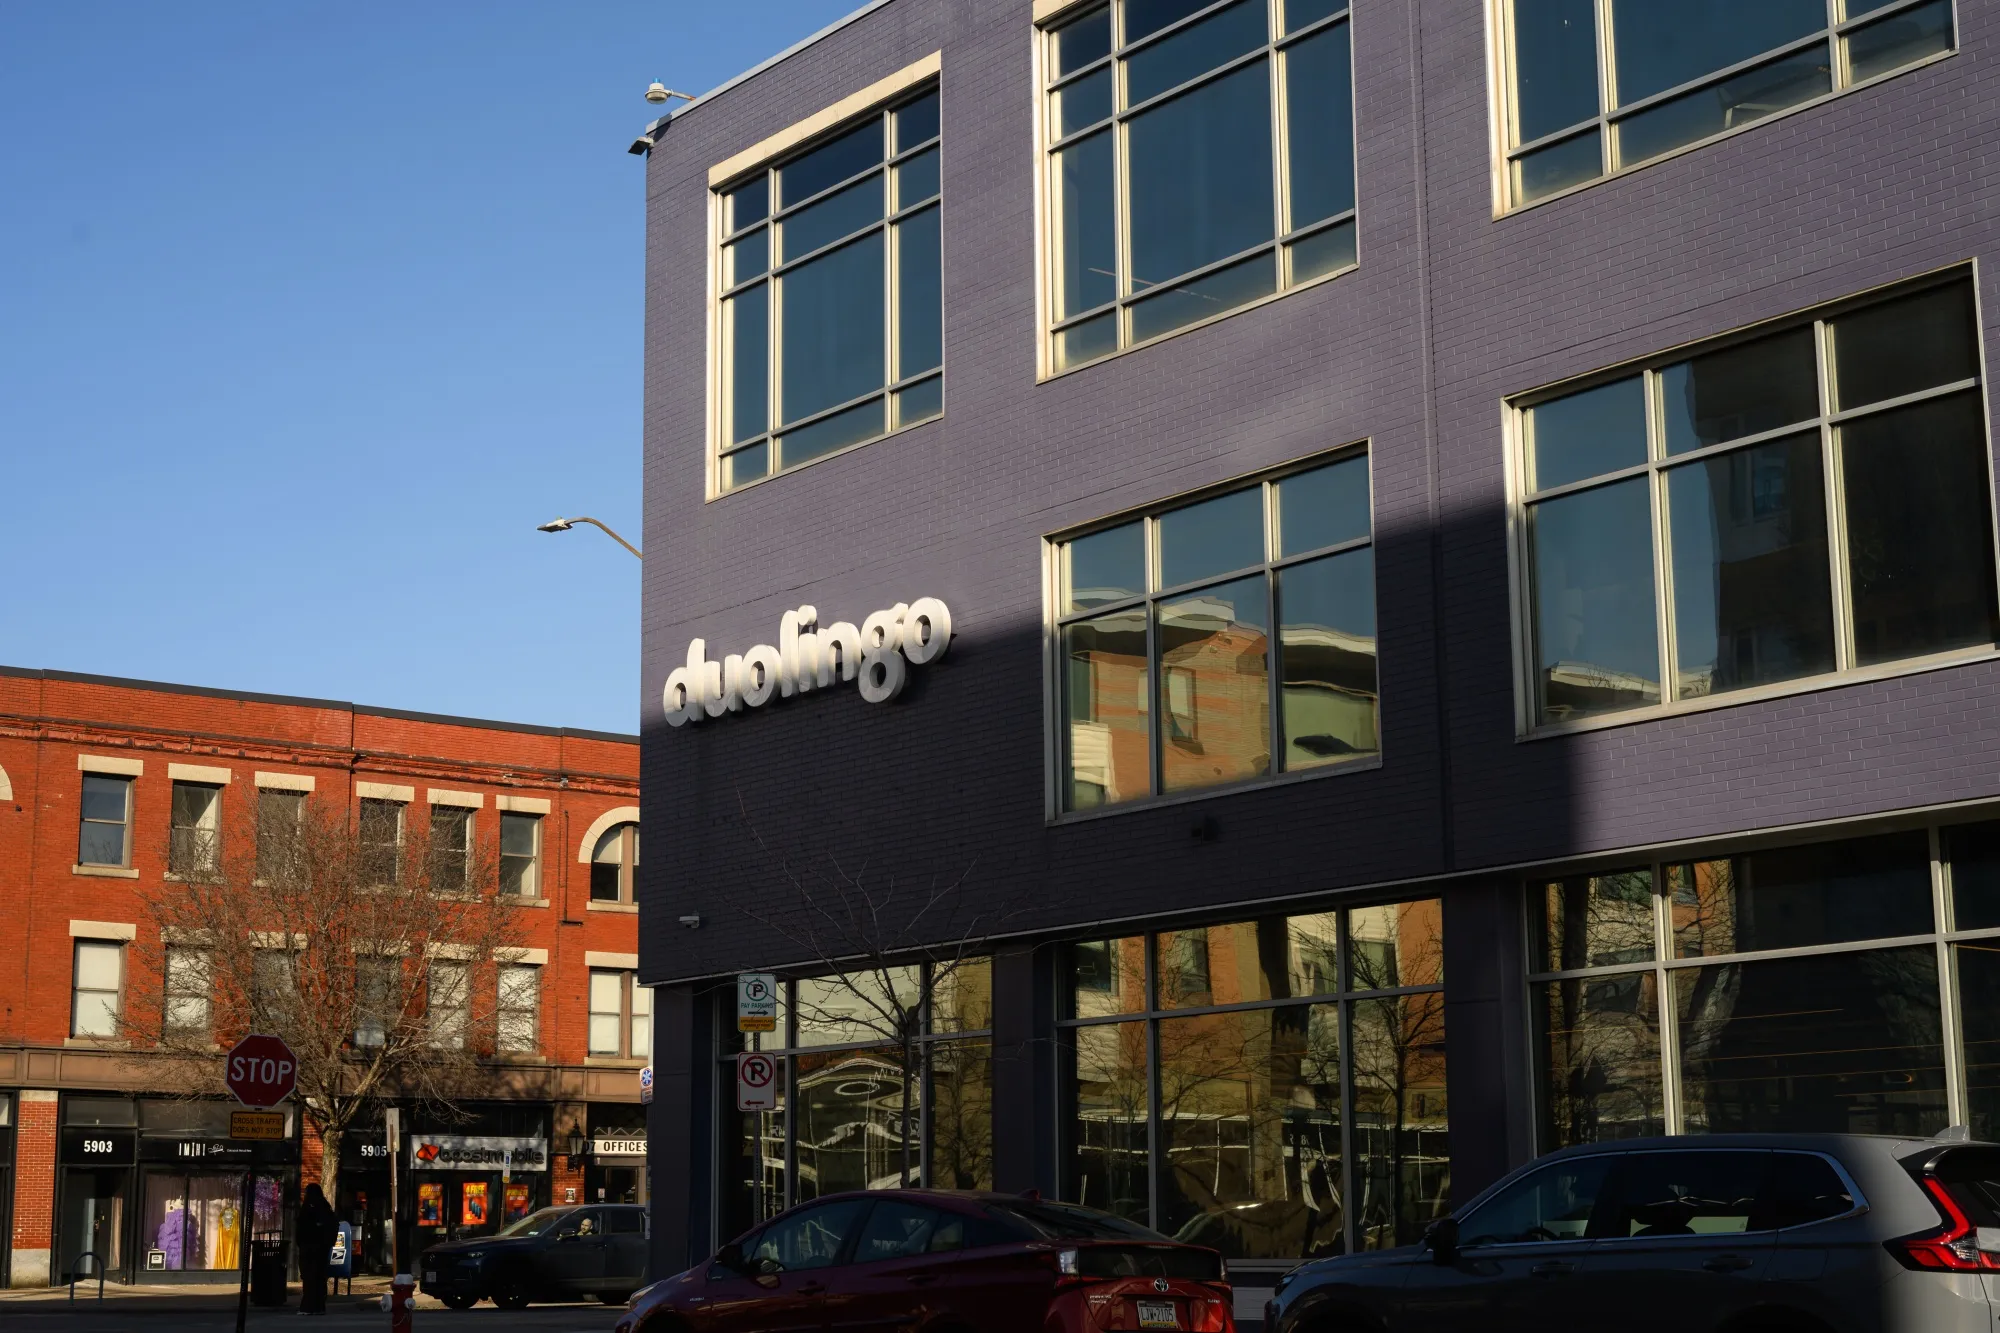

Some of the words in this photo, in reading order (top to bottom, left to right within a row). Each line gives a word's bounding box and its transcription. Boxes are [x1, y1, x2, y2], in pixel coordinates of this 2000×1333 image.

[663, 596, 952, 727] duolingo
[753, 984, 764, 997] P
[230, 1056, 293, 1085] STOP
[233, 1117, 254, 1125] CROSS
[256, 1117, 282, 1125] TRAFFIC
[251, 1126, 265, 1134] NOT
[266, 1127, 282, 1135] STOP
[83, 1140, 113, 1153] 5903
[361, 1145, 387, 1157] 5905
[603, 1142, 648, 1152] OFFICES
